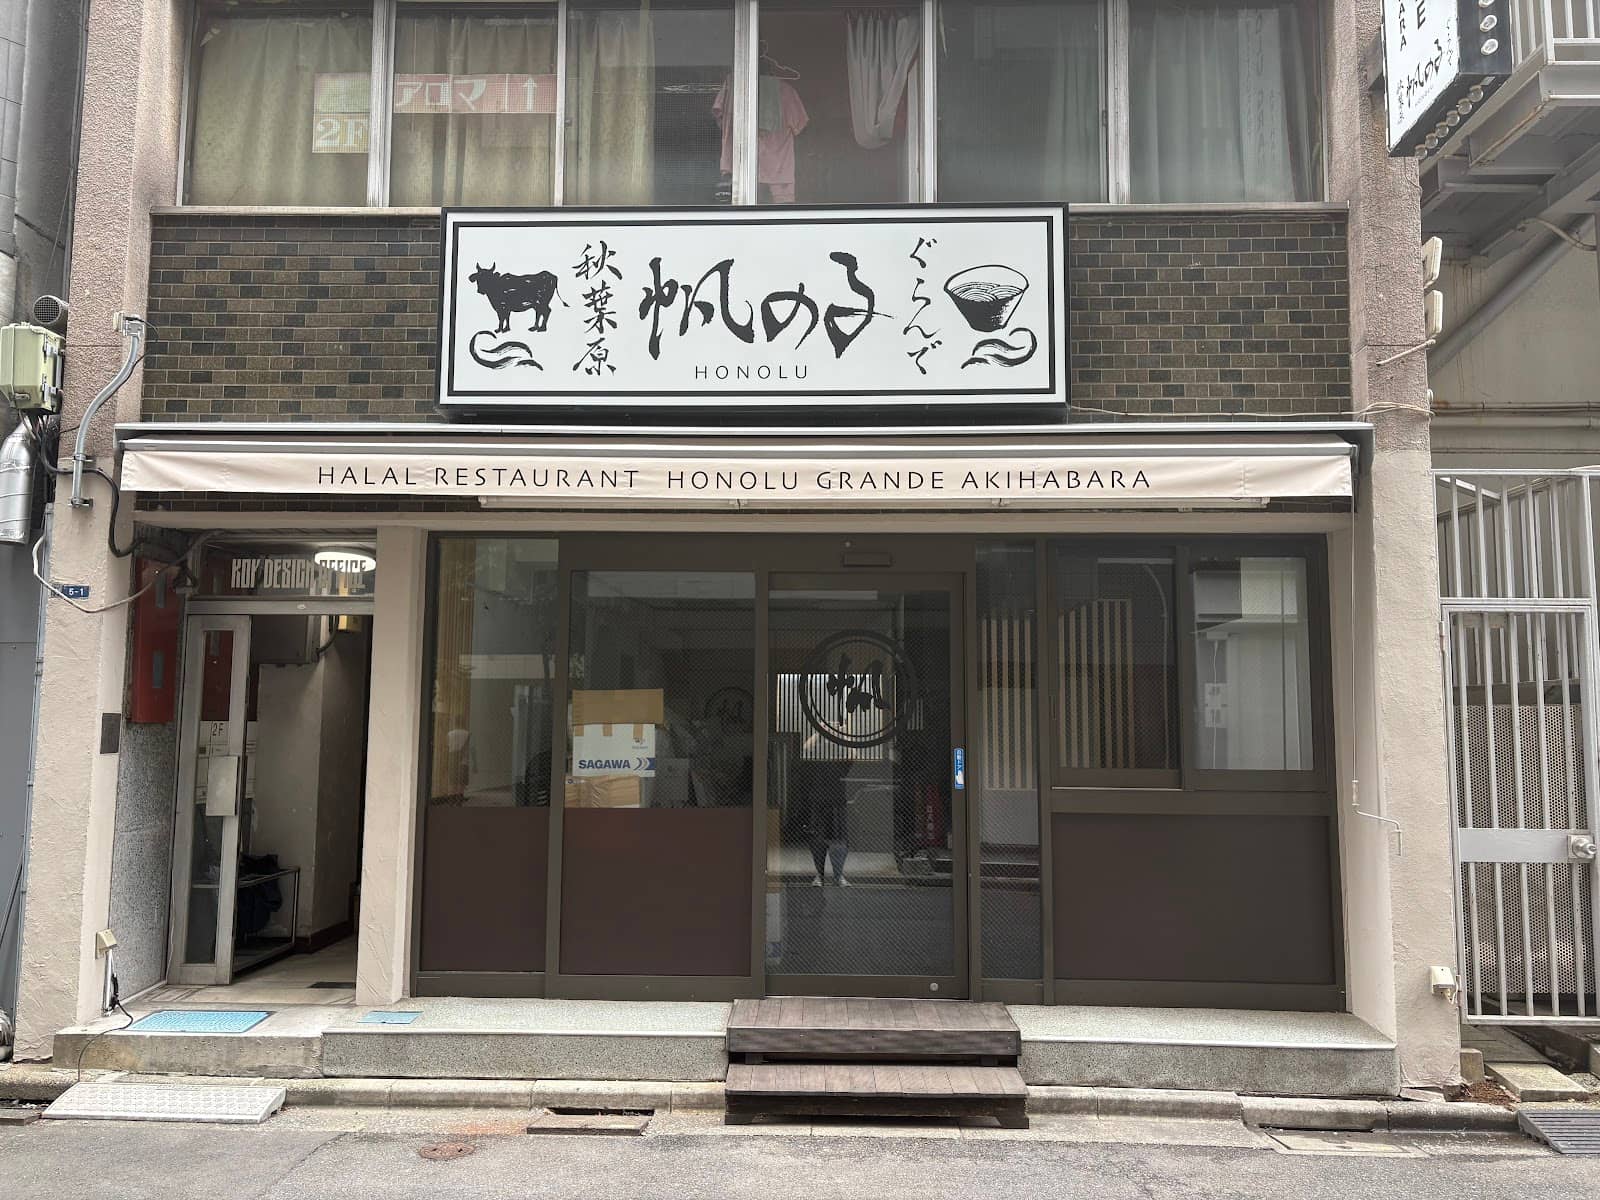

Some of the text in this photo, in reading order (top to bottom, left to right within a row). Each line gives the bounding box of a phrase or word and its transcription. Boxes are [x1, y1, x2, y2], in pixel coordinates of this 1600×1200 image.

[396, 78, 487, 111] アロマ
[316, 118, 369, 148] 2F
[572, 240, 623, 376] 秋葉原
[903, 237, 943, 375] ぐらんで
[695, 365, 807, 380] HONOLU
[318, 466, 1151, 490] HALAL RESTAURANT HONOLU GRANDE AKIHABARA
[263, 558, 317, 589] DESIGN
[318, 559, 366, 589] OFFICE
[69, 587, 84, 597] 5-1
[212, 722, 224, 737] 2F
[578, 759, 631, 770] SAGAWA
